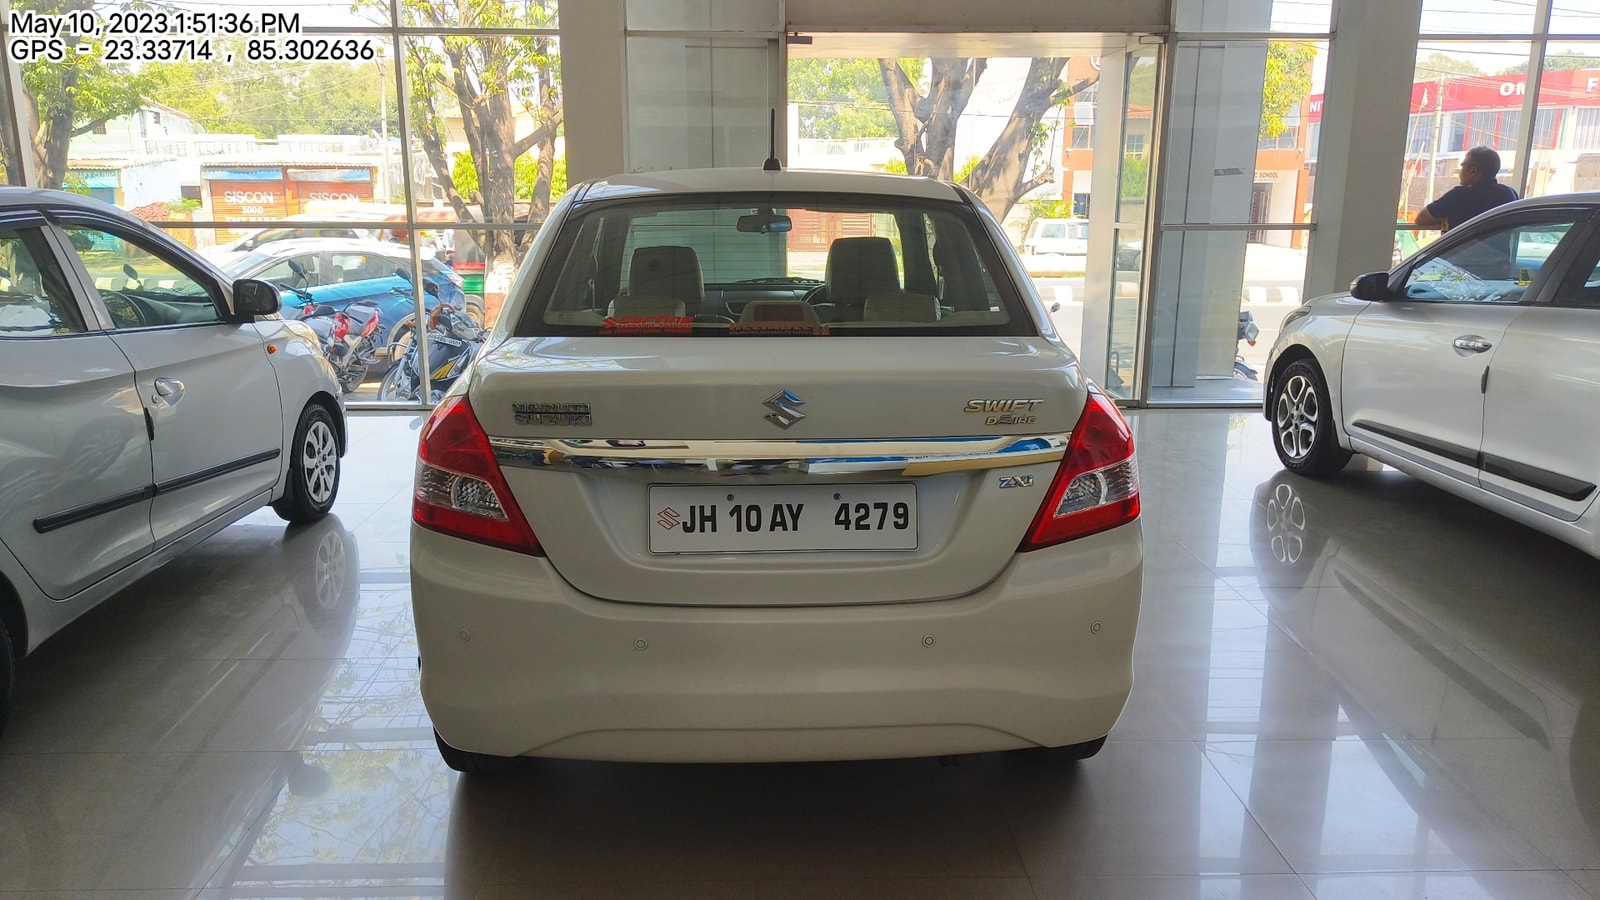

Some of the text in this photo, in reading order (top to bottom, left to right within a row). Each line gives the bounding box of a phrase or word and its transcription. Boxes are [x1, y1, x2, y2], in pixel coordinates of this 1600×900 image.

[224, 191, 274, 204] SISCON
[512, 402, 591, 413] MARUTI
[964, 399, 1045, 413] SWIFT
[514, 413, 592, 426] SUZUKI
[682, 502, 909, 533] JH 10 AY 4279
